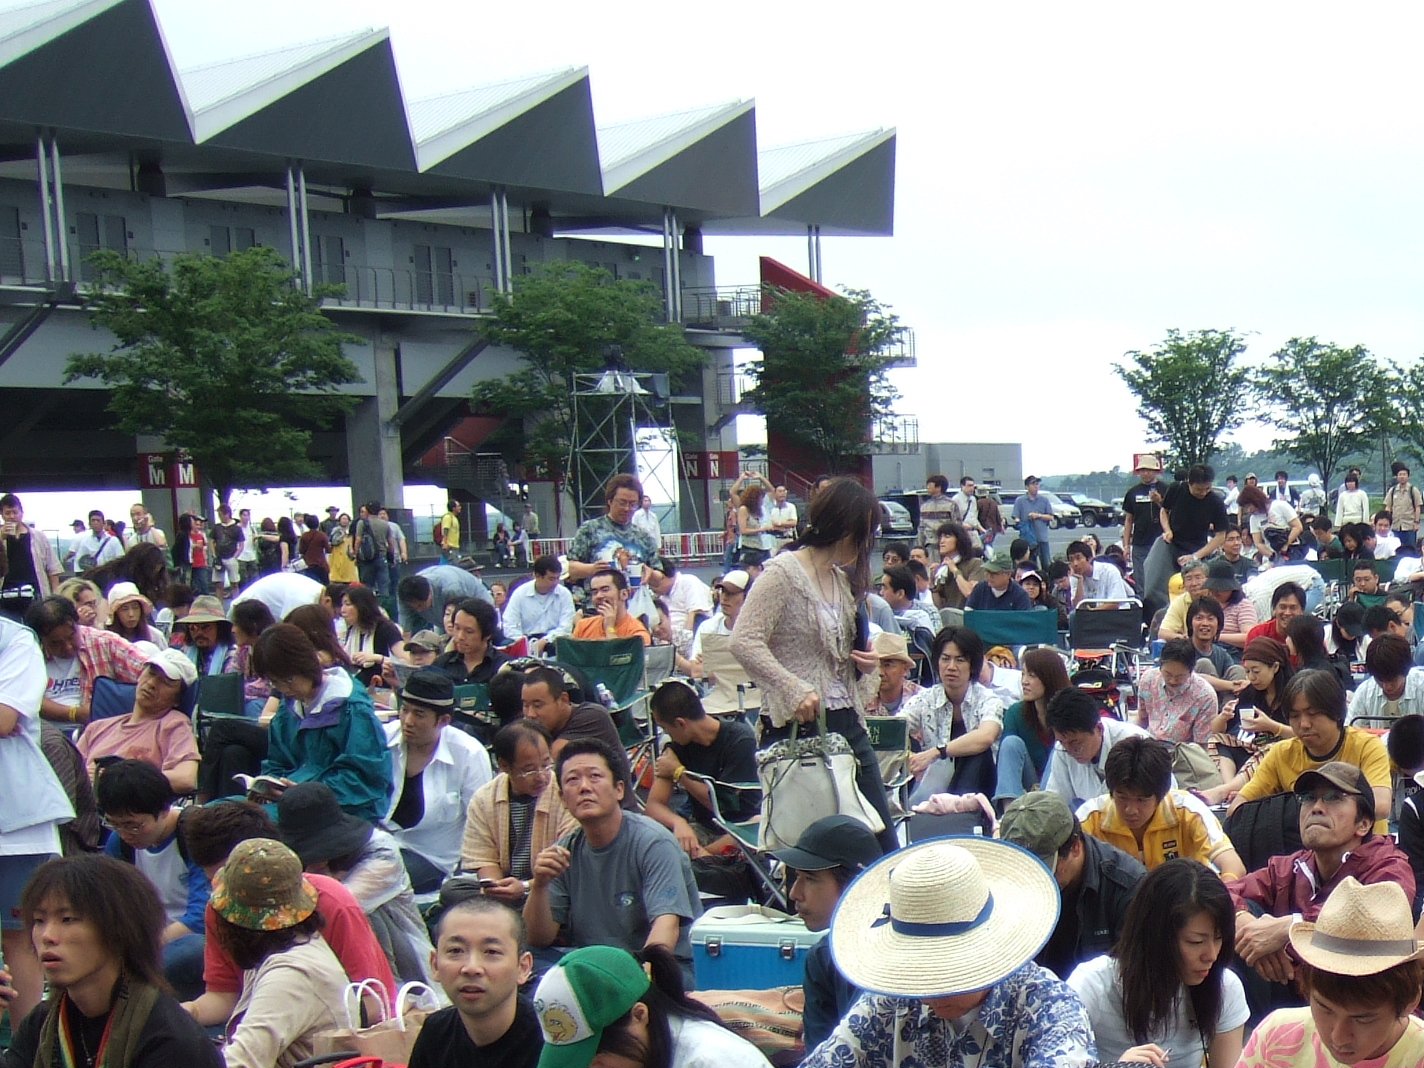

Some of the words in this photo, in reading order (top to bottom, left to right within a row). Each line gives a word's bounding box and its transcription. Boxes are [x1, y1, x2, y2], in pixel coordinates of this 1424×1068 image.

[178, 463, 196, 485] M
[686, 460, 698, 477] N
[710, 460, 719, 477] N
